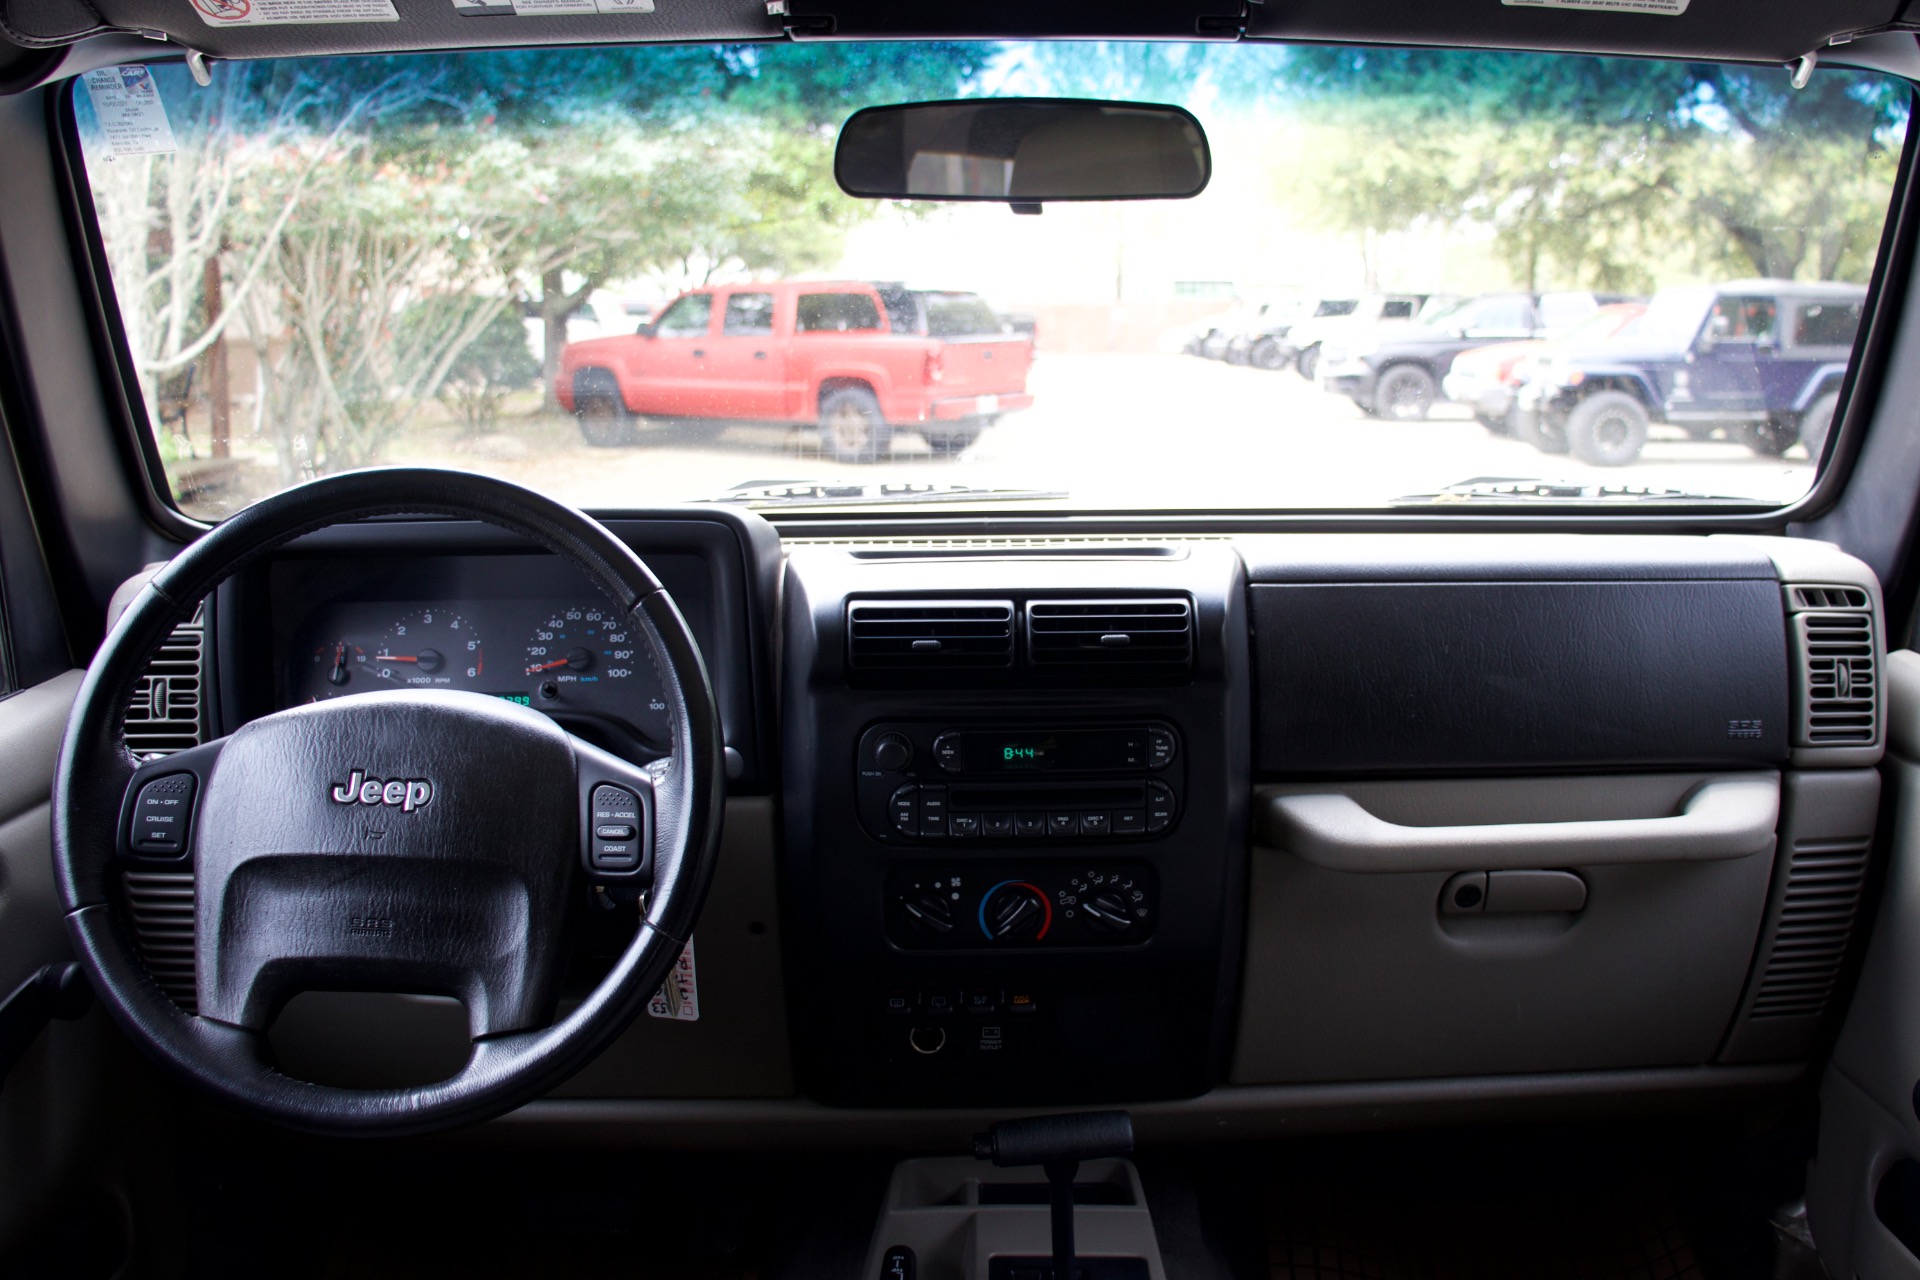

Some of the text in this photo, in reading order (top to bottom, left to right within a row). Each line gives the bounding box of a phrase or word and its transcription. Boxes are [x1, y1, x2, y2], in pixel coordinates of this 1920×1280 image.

[424, 614, 432, 623] 3
[566, 612, 581, 620] 50
[586, 612, 601, 621] 60
[450, 621, 459, 629] 4
[548, 620, 564, 629] 40
[602, 621, 617, 630] 70
[397, 626, 406, 635] 2
[538, 632, 553, 641] 30
[610, 634, 625, 642] 80
[467, 641, 476, 650] 5
[530, 647, 546, 655] 20
[614, 650, 630, 659] 90
[382, 668, 390, 678] 0
[467, 668, 476, 677] 6
[608, 669, 627, 677] 100
[332, 771, 432, 812] Jeep
